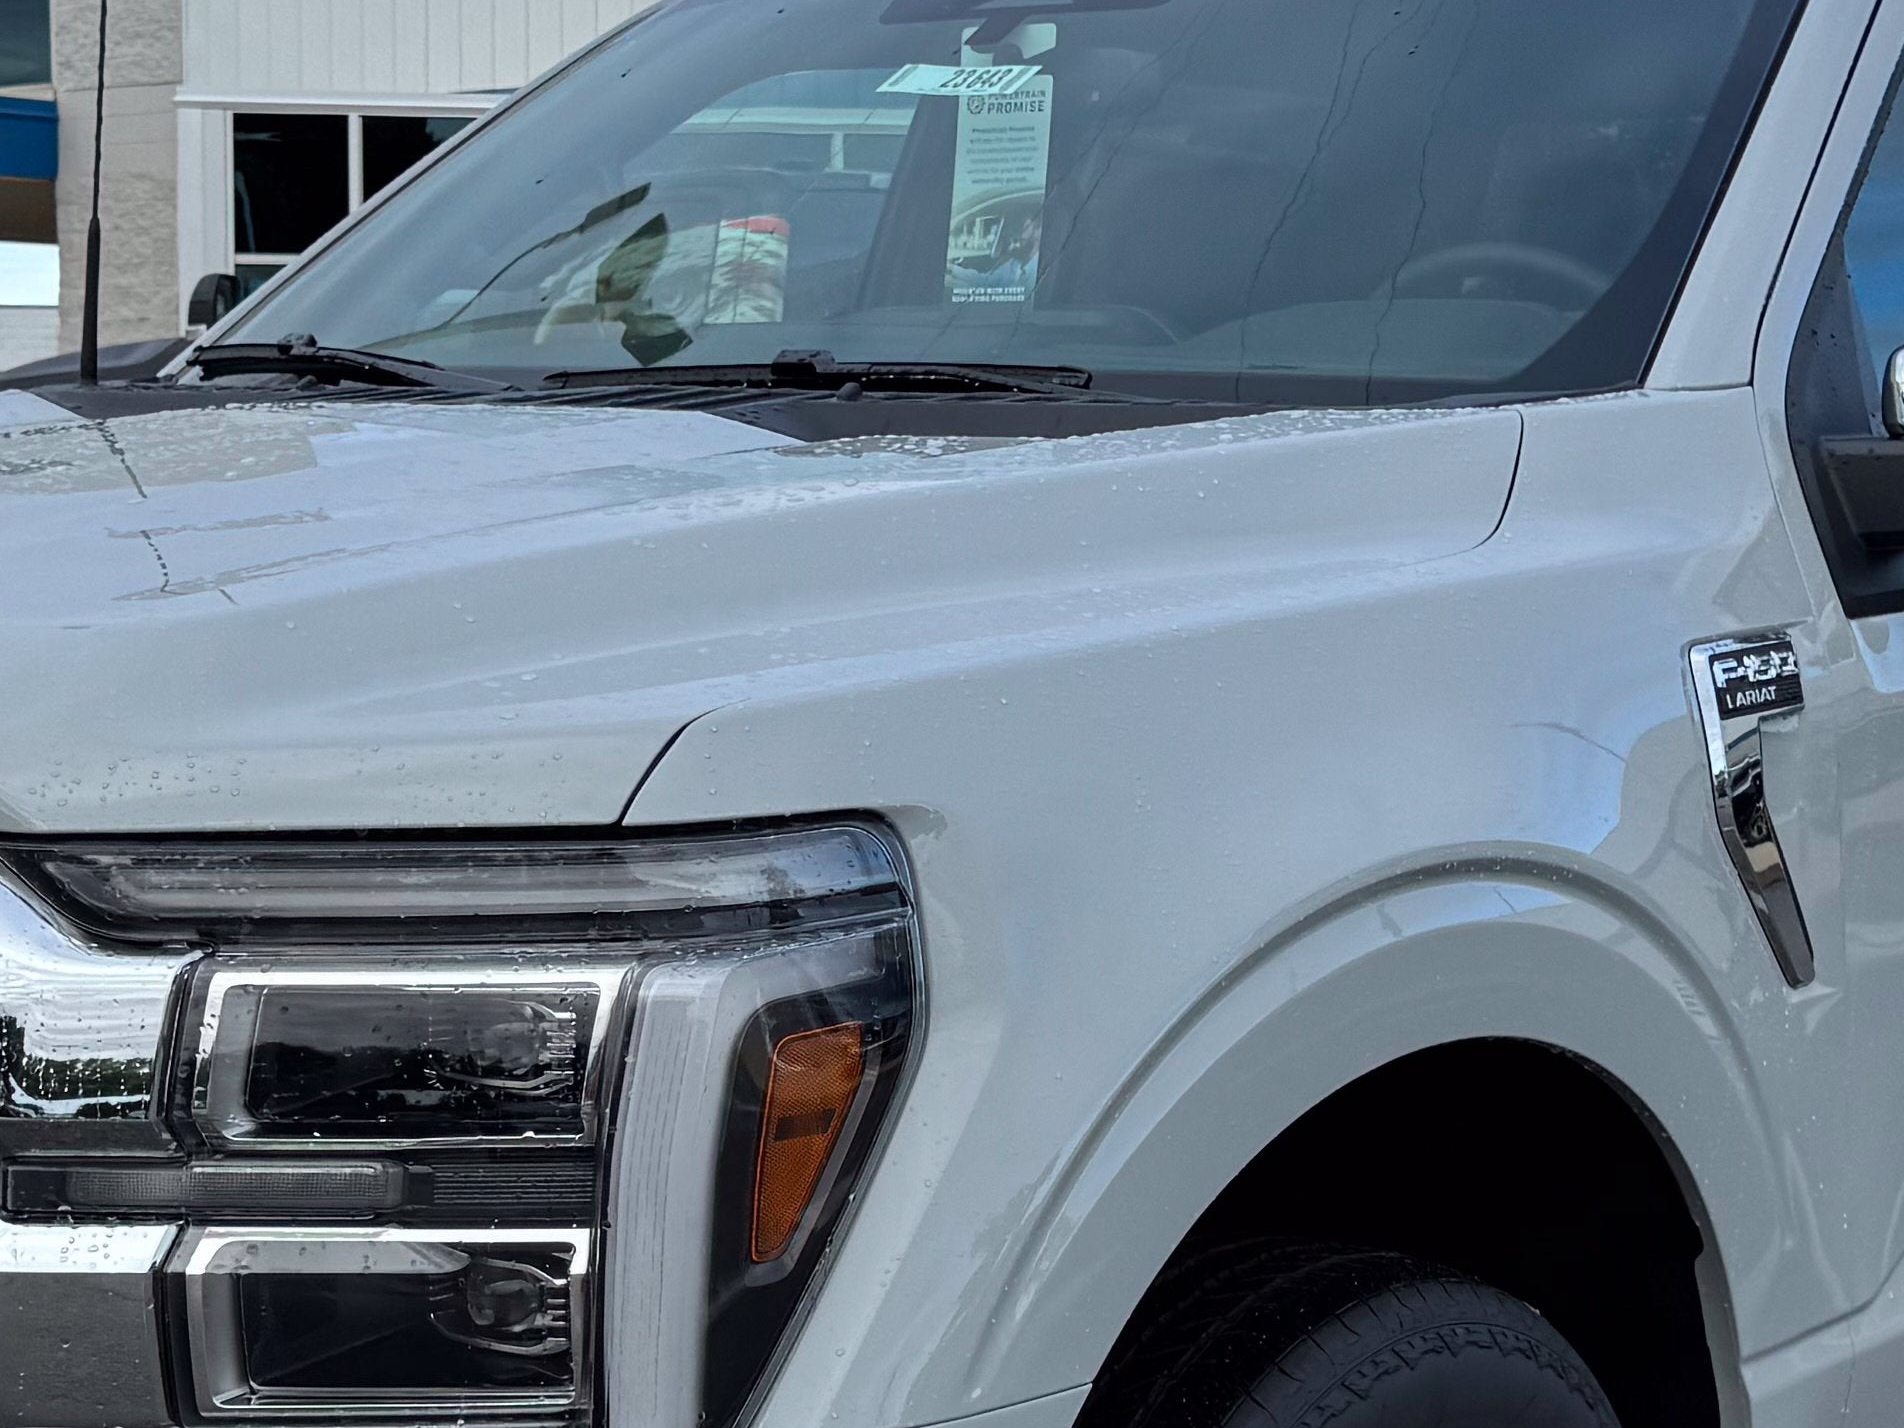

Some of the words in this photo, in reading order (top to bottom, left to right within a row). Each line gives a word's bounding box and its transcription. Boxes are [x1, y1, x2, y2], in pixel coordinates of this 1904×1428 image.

[939, 68, 1013, 89] 23643
[988, 100, 1045, 114] PROMISE
[1726, 686, 1777, 709] LARIAT
